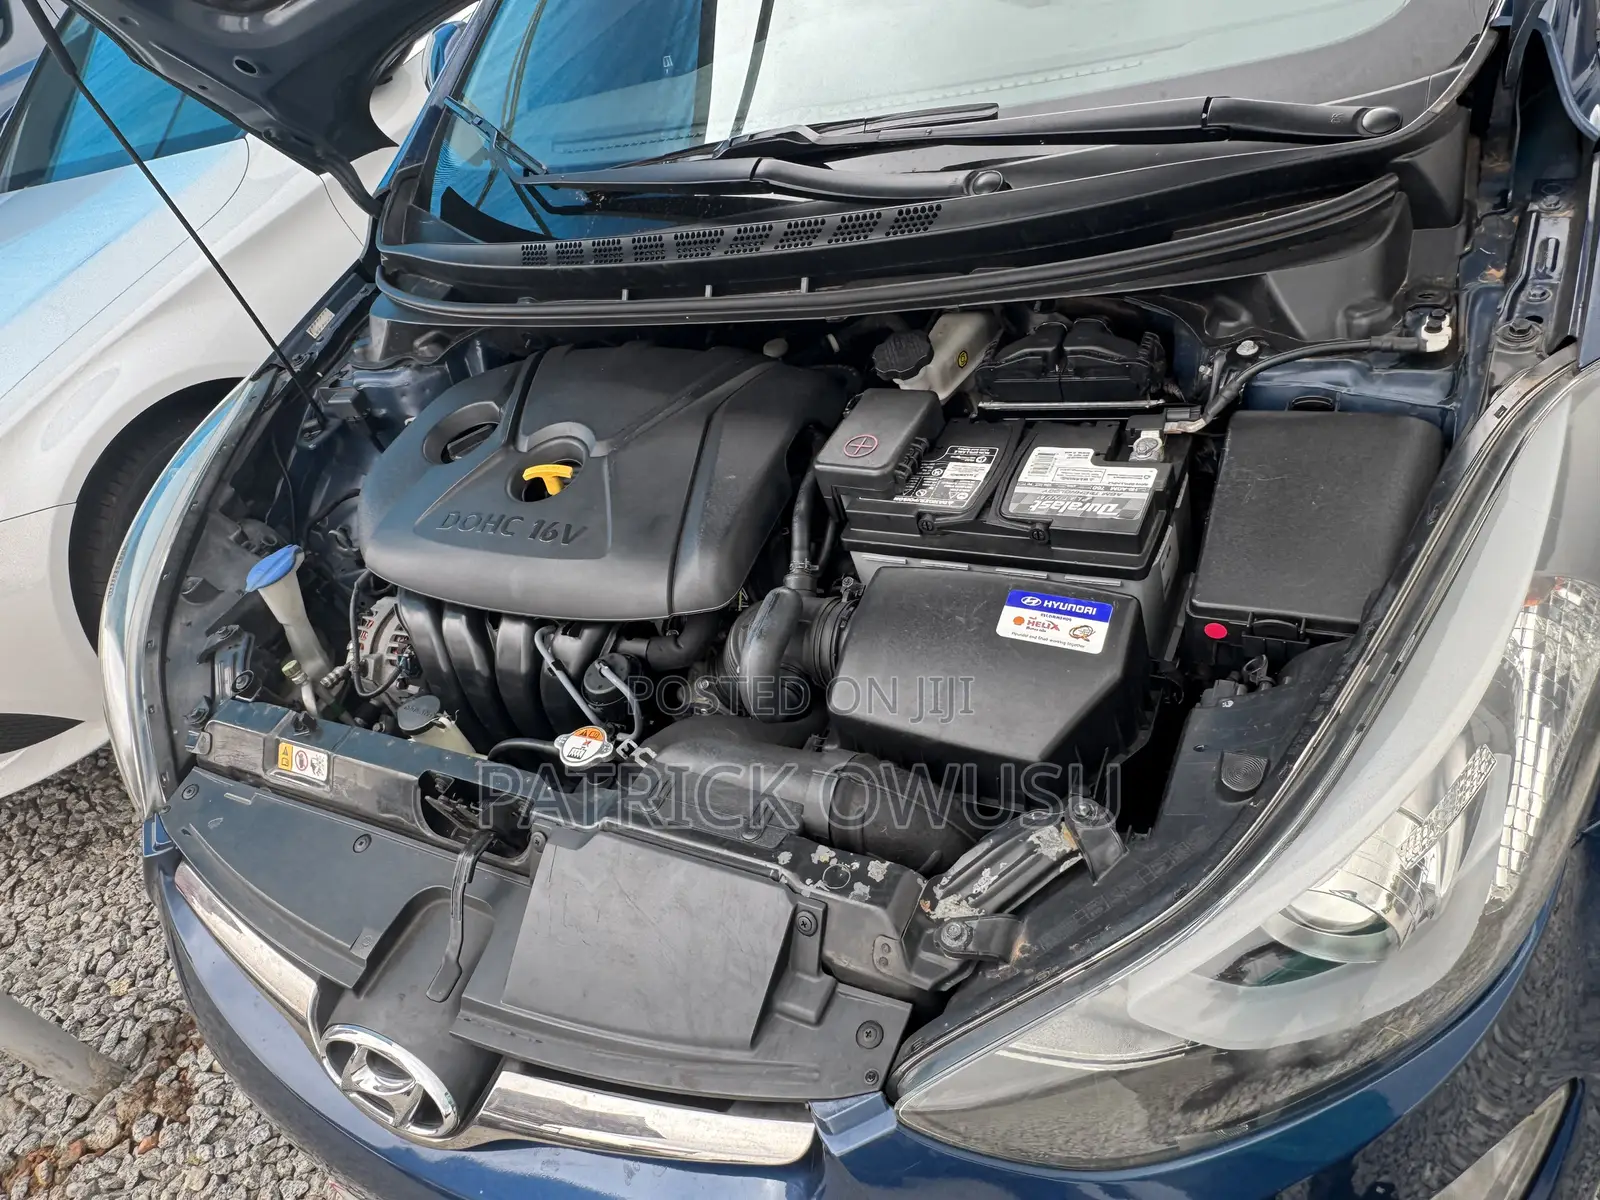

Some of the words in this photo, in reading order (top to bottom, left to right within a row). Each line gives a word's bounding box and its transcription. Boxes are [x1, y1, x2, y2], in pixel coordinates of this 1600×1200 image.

[1029, 499, 1119, 516] Duralast
[435, 510, 525, 538] DOHC
[527, 519, 588, 546] 16V
[1043, 599, 1097, 616] HYUNDAI
[1026, 619, 1061, 631] HELIX
